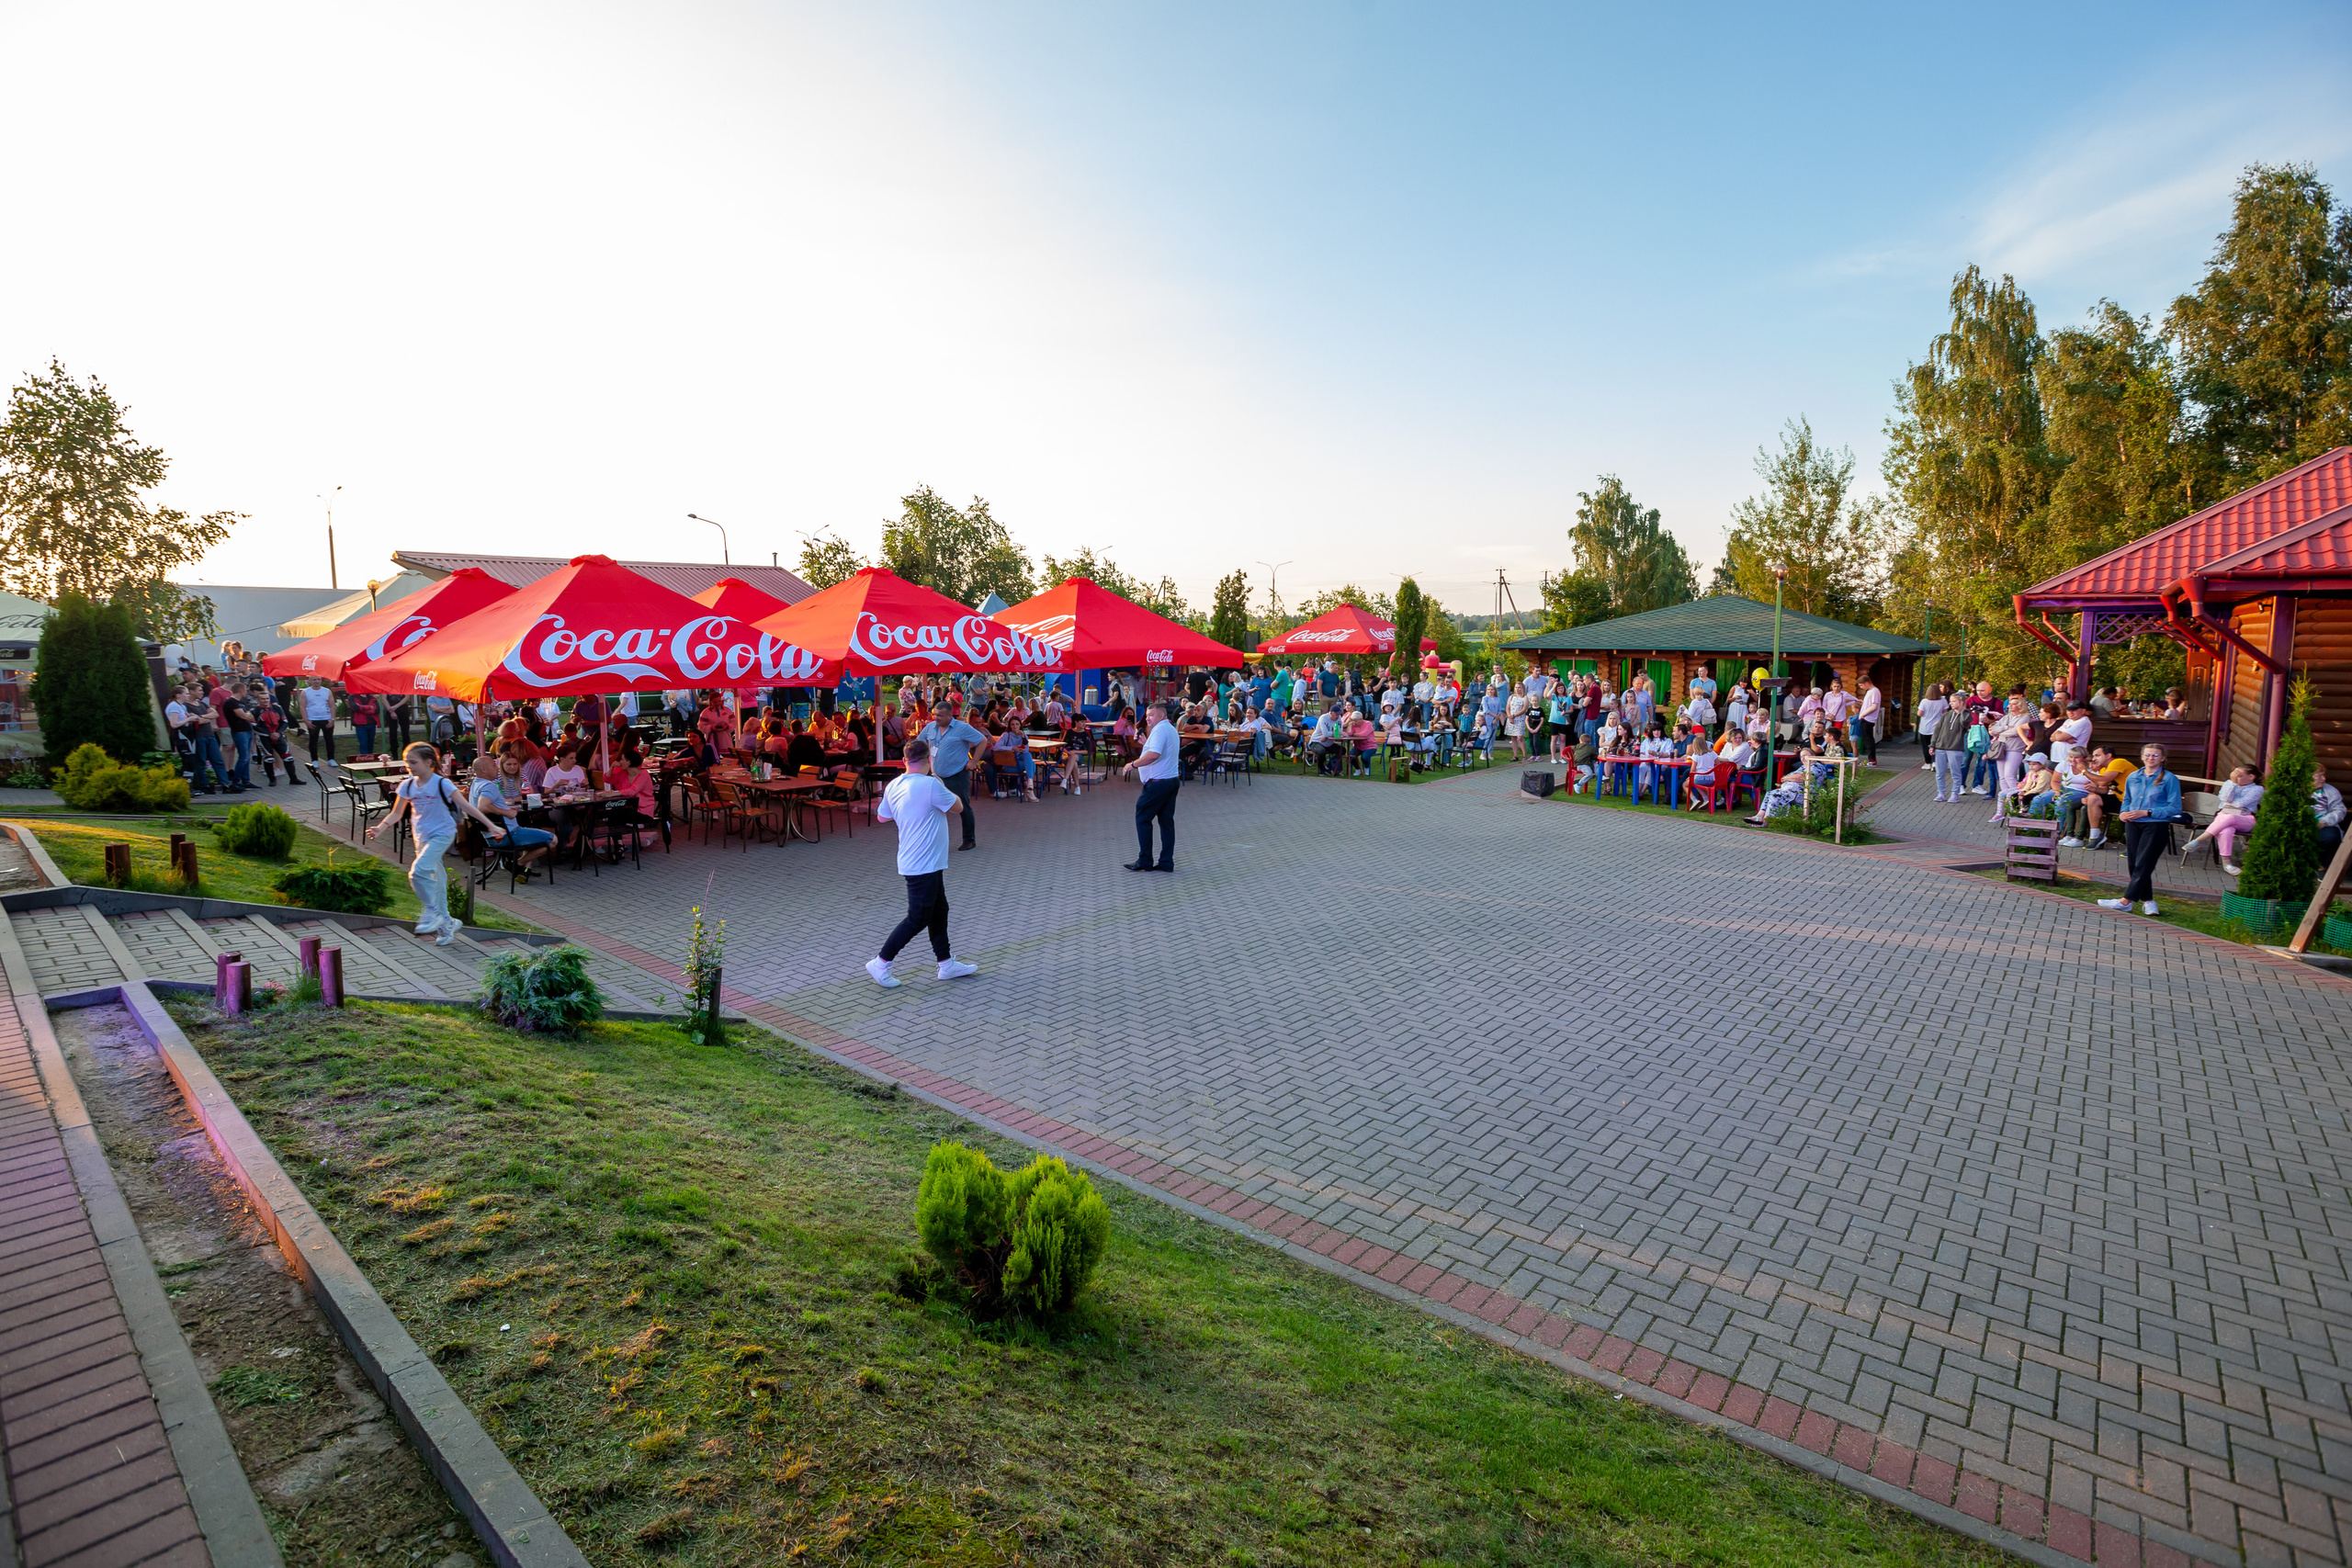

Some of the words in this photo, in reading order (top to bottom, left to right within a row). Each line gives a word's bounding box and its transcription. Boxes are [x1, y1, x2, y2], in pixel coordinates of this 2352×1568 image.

[503, 614, 823, 688] Coca-Cola
[849, 612, 1062, 666] Coca-Cola
[1286, 628, 1359, 643] Coca-Cola
[1147, 649, 1173, 662] Coca-Cola
